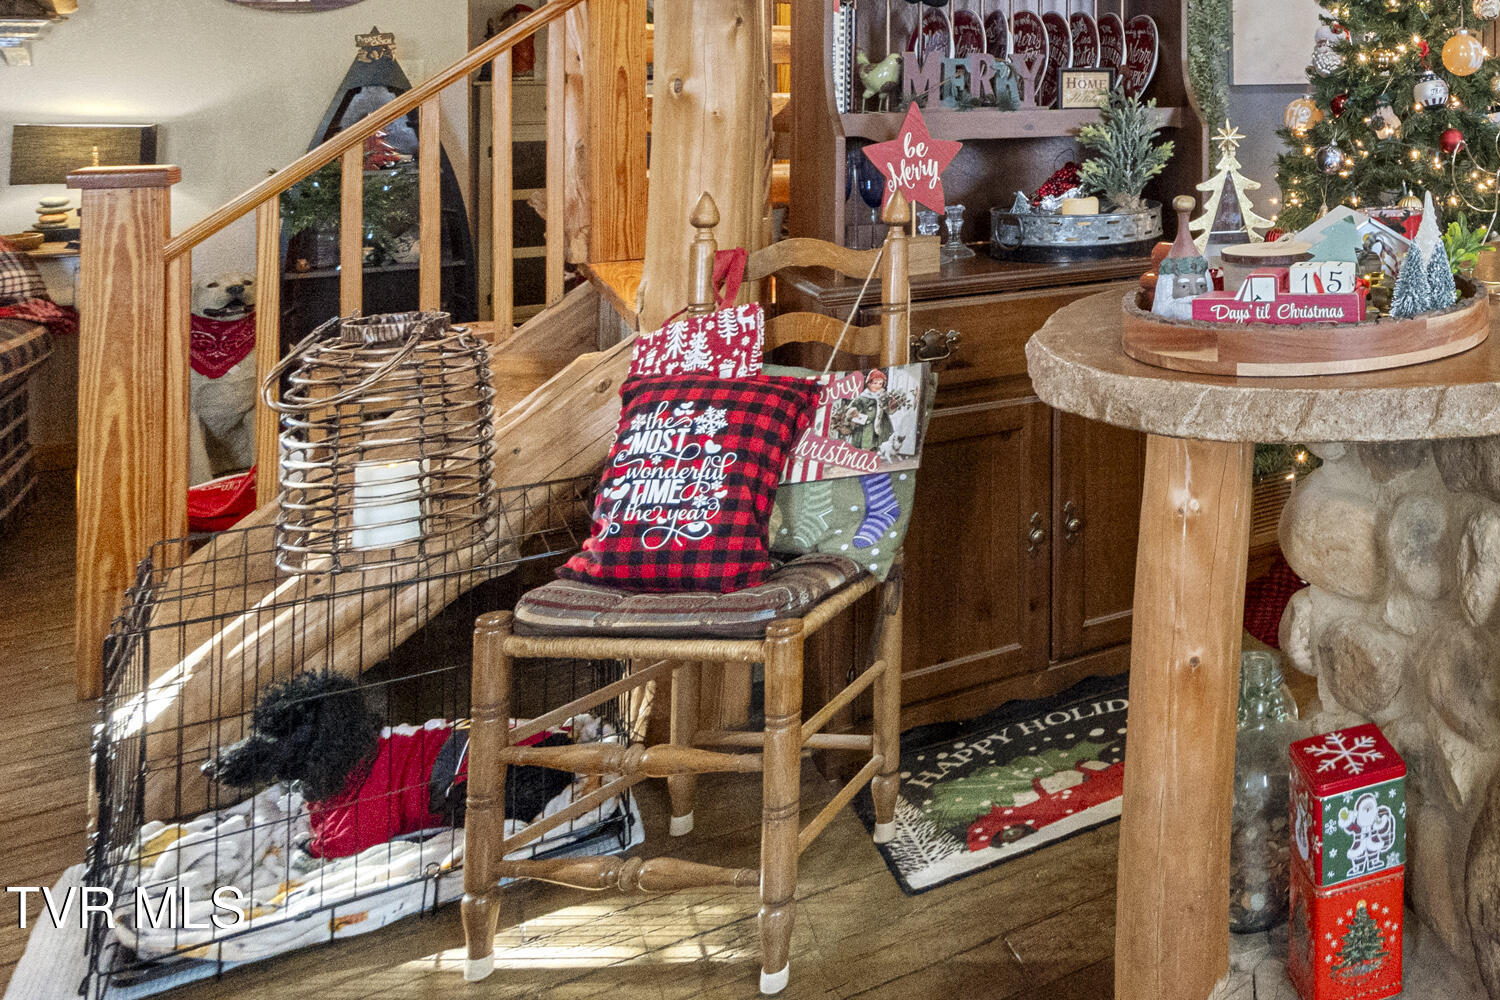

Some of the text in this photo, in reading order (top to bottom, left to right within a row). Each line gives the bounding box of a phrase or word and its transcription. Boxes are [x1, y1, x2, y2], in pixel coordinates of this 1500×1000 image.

[1066, 76, 1108, 89] HOME
[903, 132, 929, 158] be
[886, 159, 941, 193] Merry
[1277, 304, 1345, 320] Christmas
[818, 375, 862, 409] erry
[646, 401, 693, 431] the
[627, 428, 691, 455] MOST
[790, 427, 881, 473] hristmas
[614, 443, 738, 501] wonderful
[623, 492, 662, 521] the
[630, 479, 686, 504] TIME
[642, 498, 721, 549] year
[907, 698, 1129, 788] HAPPY HOLID
